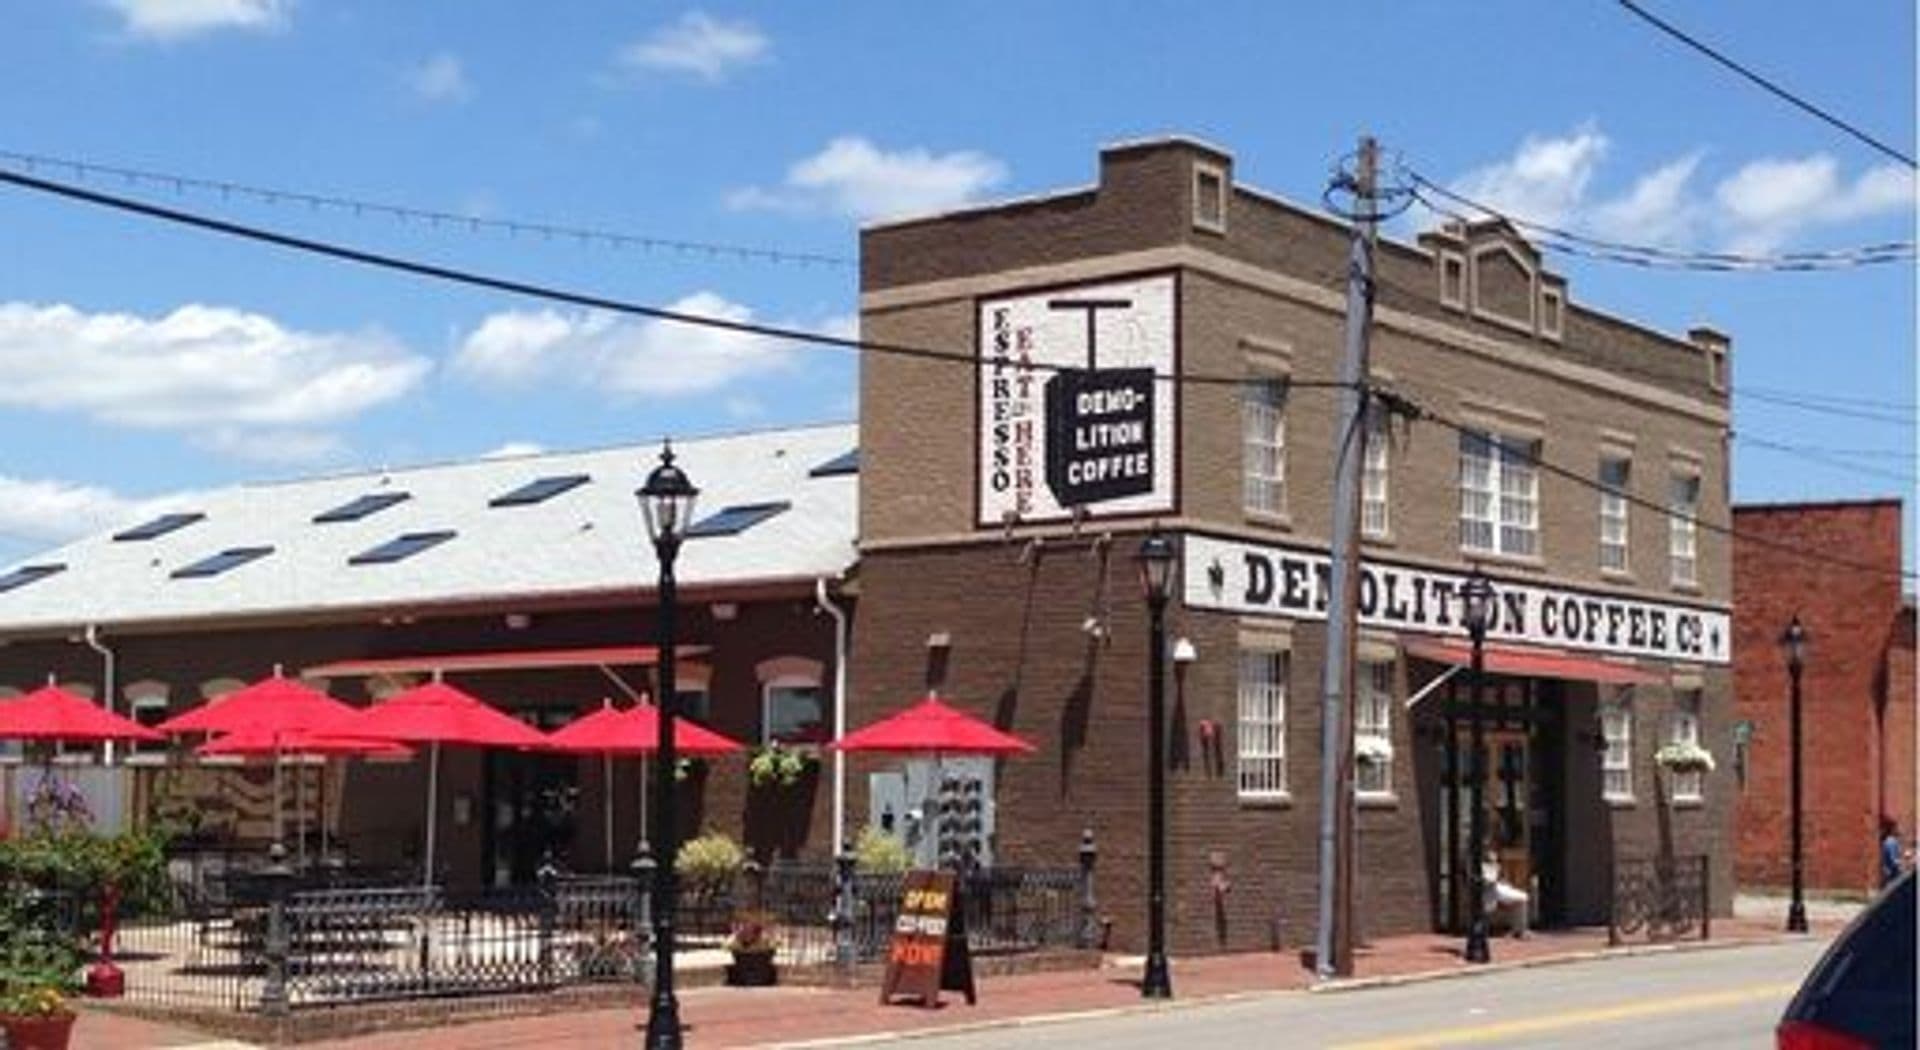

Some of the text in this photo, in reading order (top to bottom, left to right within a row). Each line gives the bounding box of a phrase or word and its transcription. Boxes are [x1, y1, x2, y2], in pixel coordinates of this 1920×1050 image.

[1016, 326, 1032, 398] EAT
[993, 308, 1009, 492] ESPRESSO
[1016, 420, 1032, 514] HERE
[1076, 421, 1144, 451] LITION
[1068, 453, 1149, 485] COFFEE
[1541, 596, 1666, 650] COFFEE
